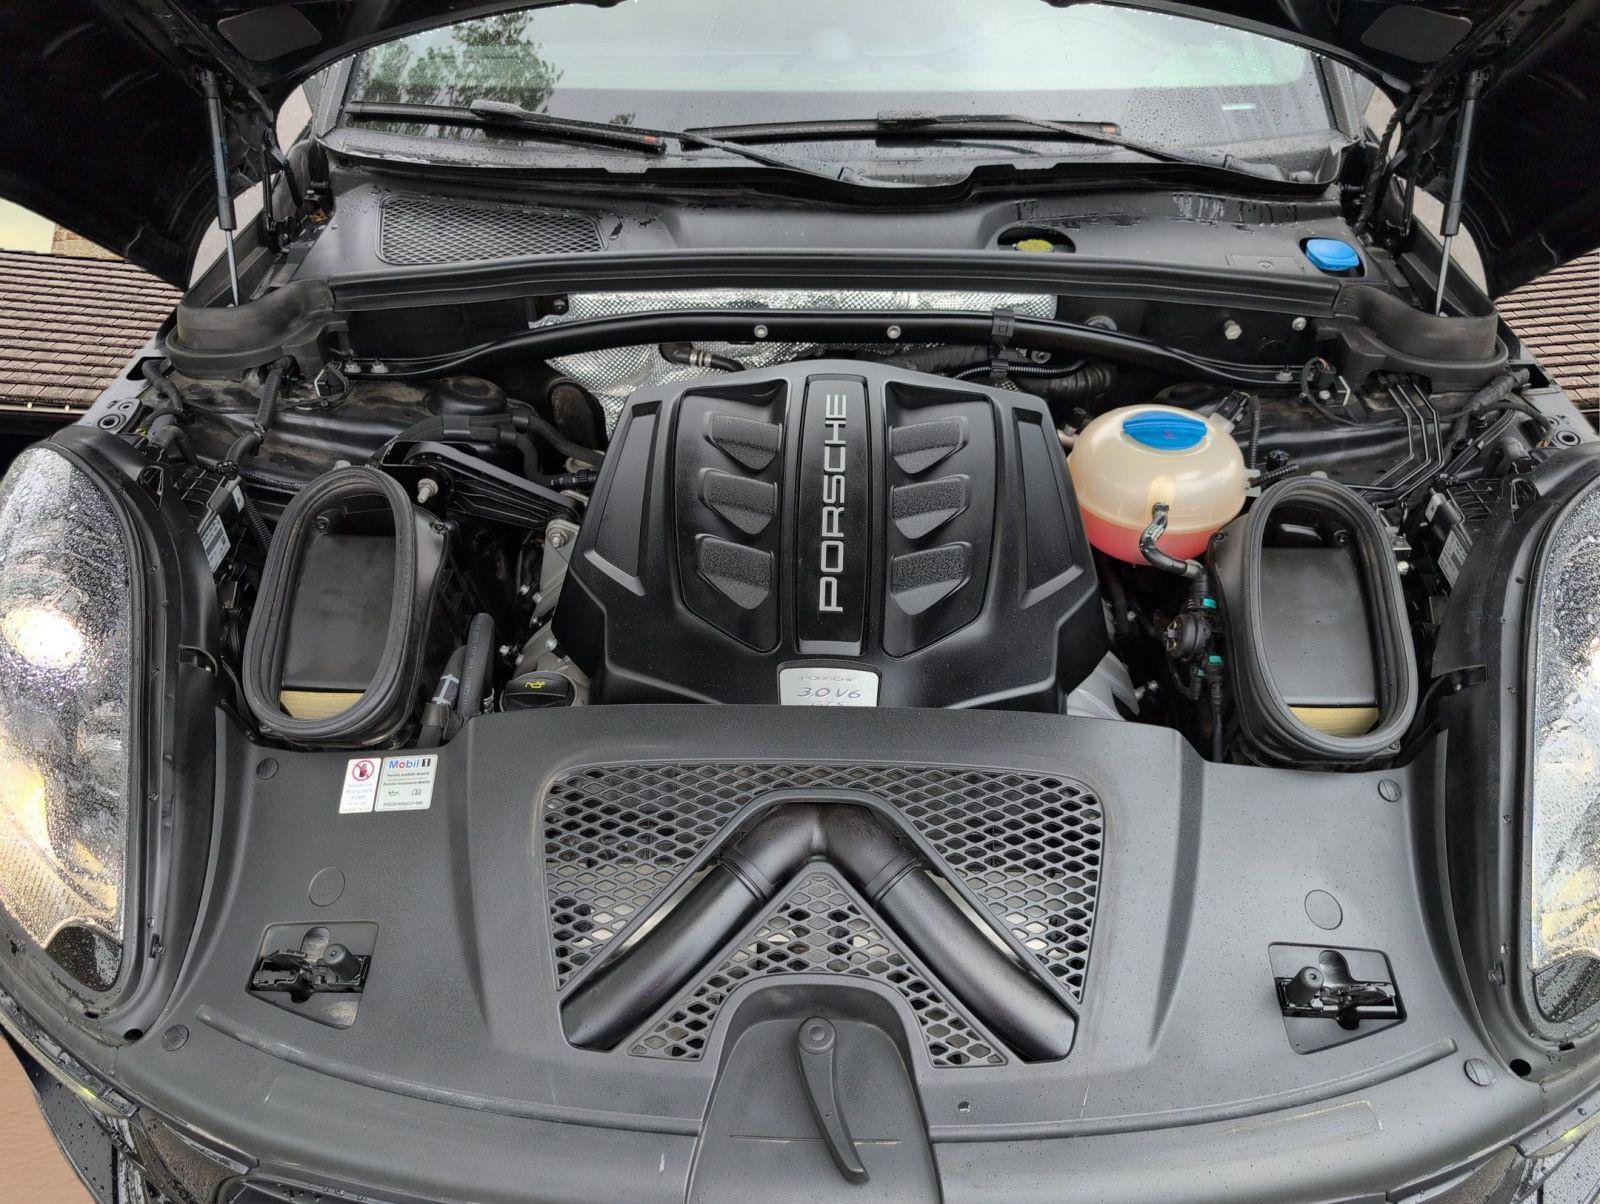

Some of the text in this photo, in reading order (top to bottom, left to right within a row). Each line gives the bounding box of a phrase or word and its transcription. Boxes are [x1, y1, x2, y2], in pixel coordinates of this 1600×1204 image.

[819, 394, 847, 612] PORSCHE
[836, 689, 861, 699] V6
[389, 760, 420, 770] Mobil
